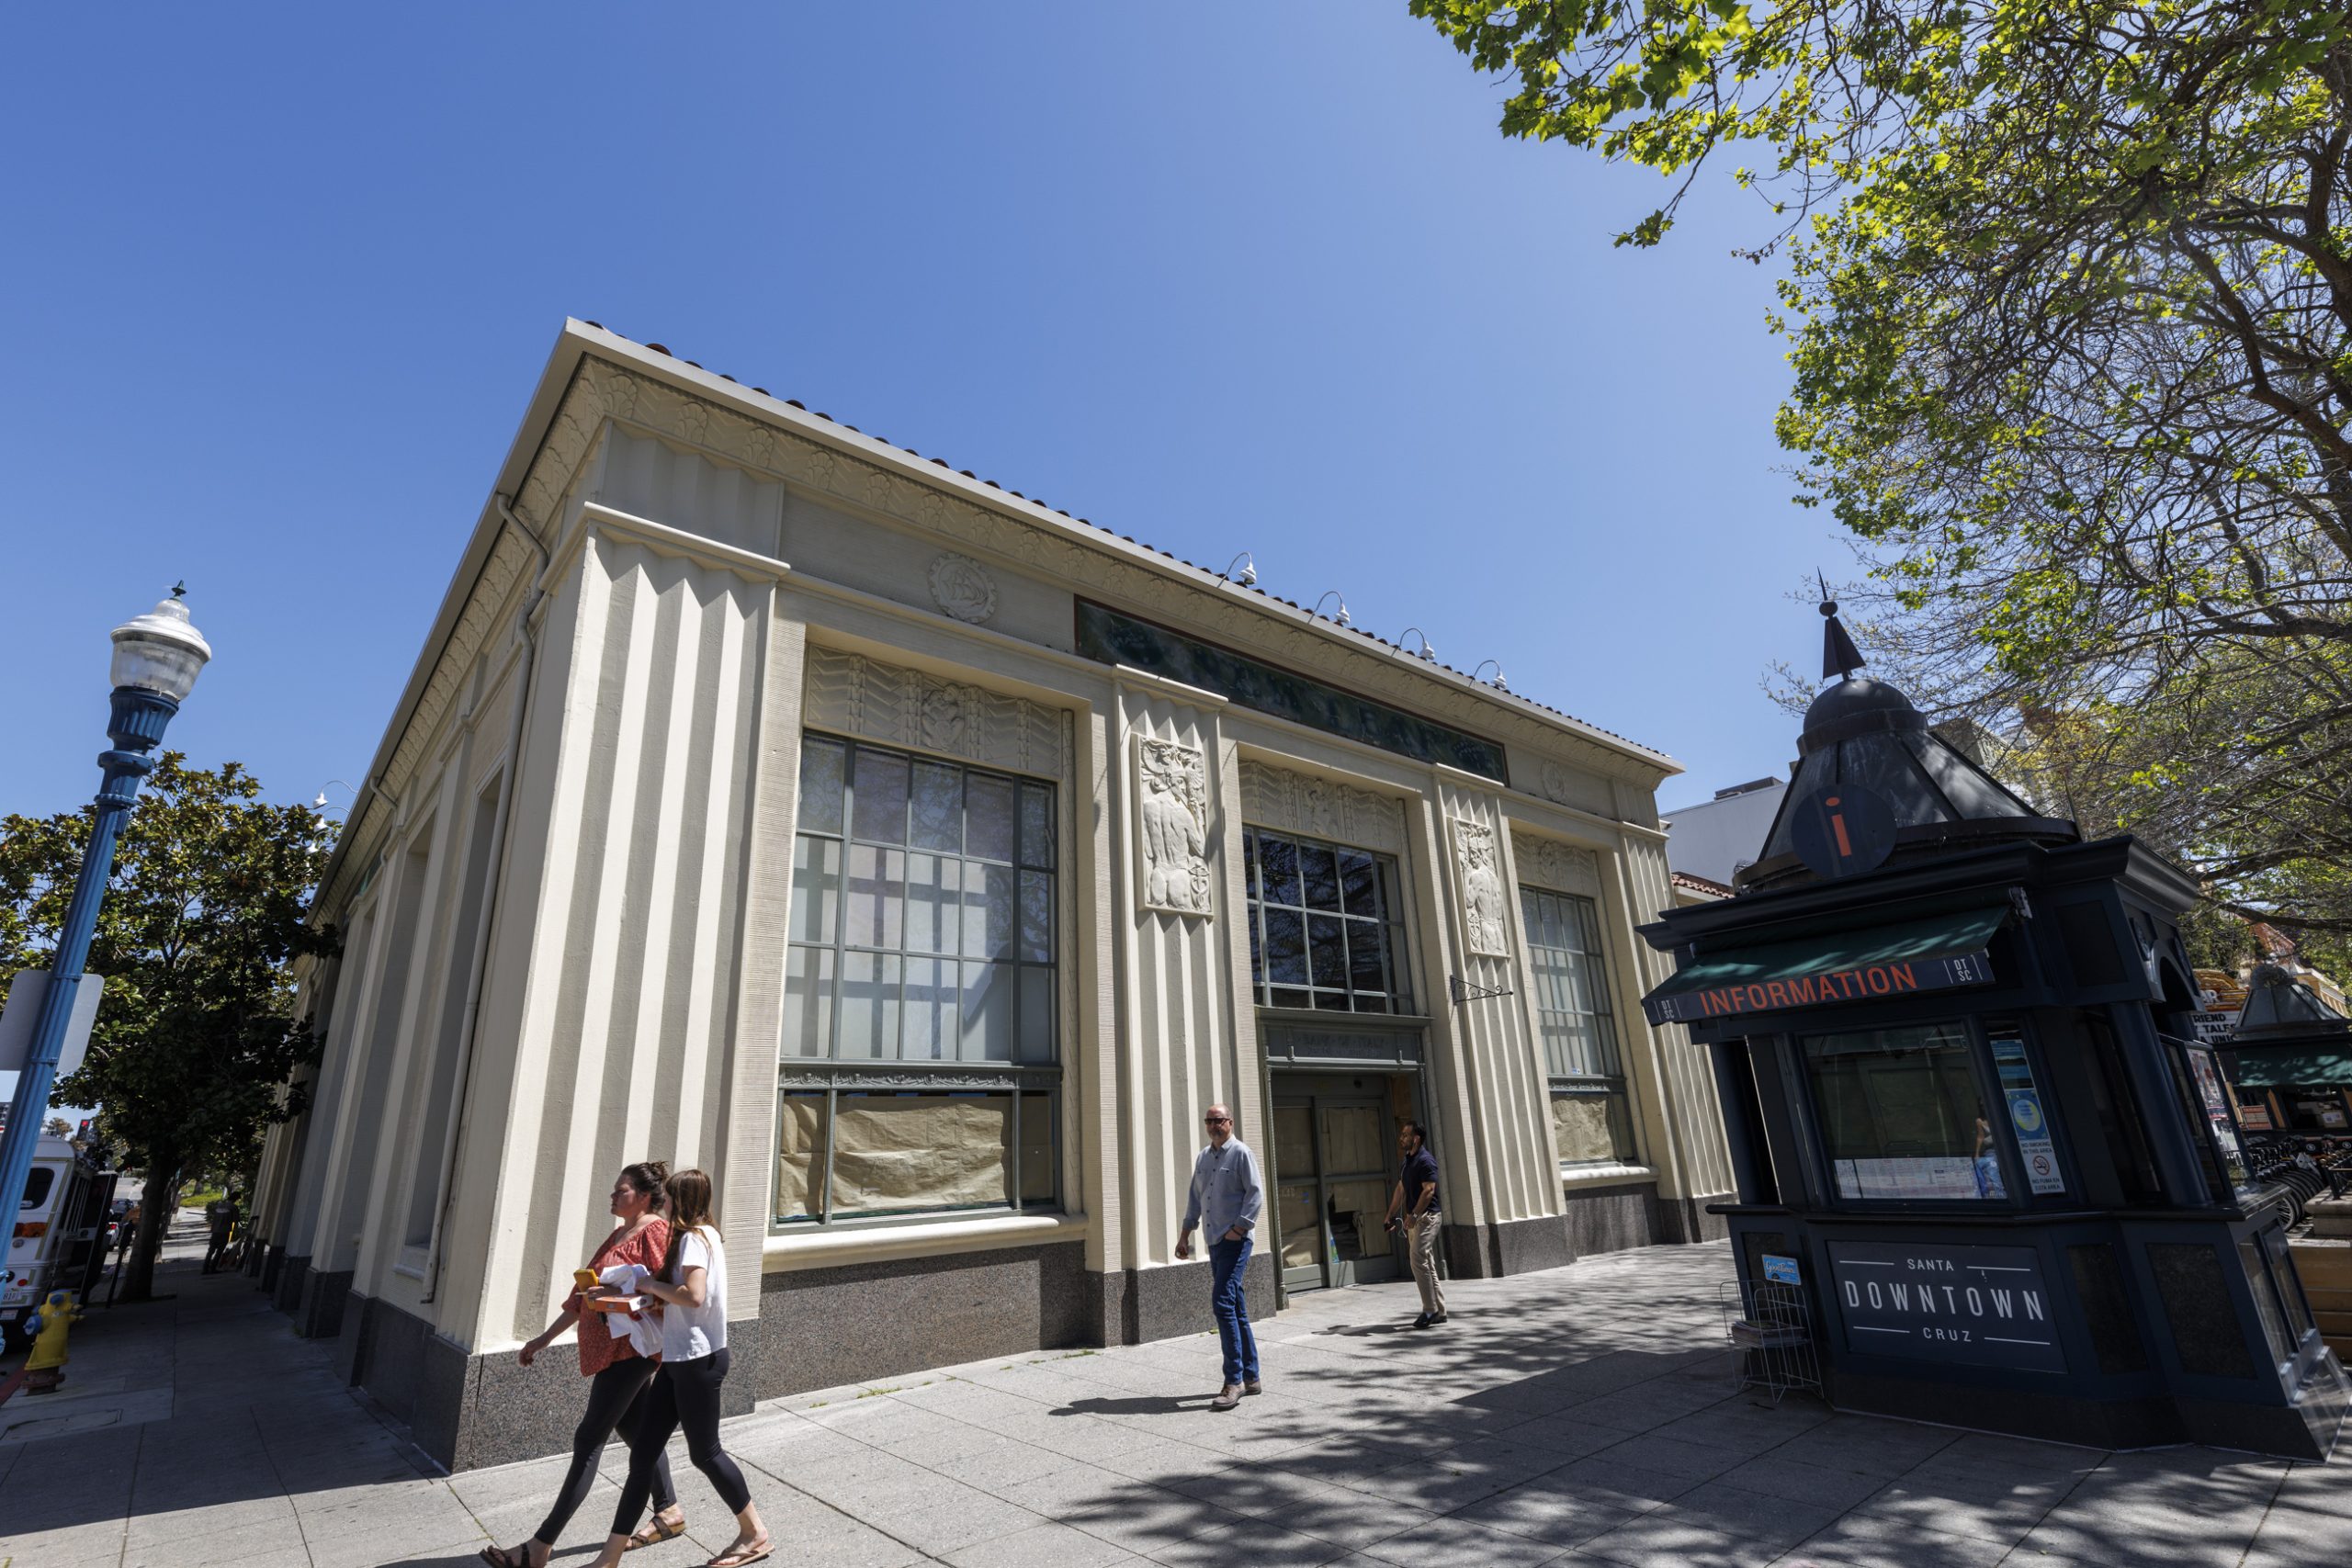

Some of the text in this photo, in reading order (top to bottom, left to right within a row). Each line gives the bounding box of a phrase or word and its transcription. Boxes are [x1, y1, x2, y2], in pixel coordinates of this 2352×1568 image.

[1826, 796, 1852, 857] i
[1954, 958, 1970, 970] DT
[1957, 969, 1973, 982] SC
[1699, 963, 1917, 1016] INFORMATION
[2192, 1013, 2226, 1023] RIEND
[1906, 1258, 1954, 1271] SANTA
[1844, 1280, 2044, 1322] DOWNTOWN
[1923, 1327, 1972, 1343] CRUZ
